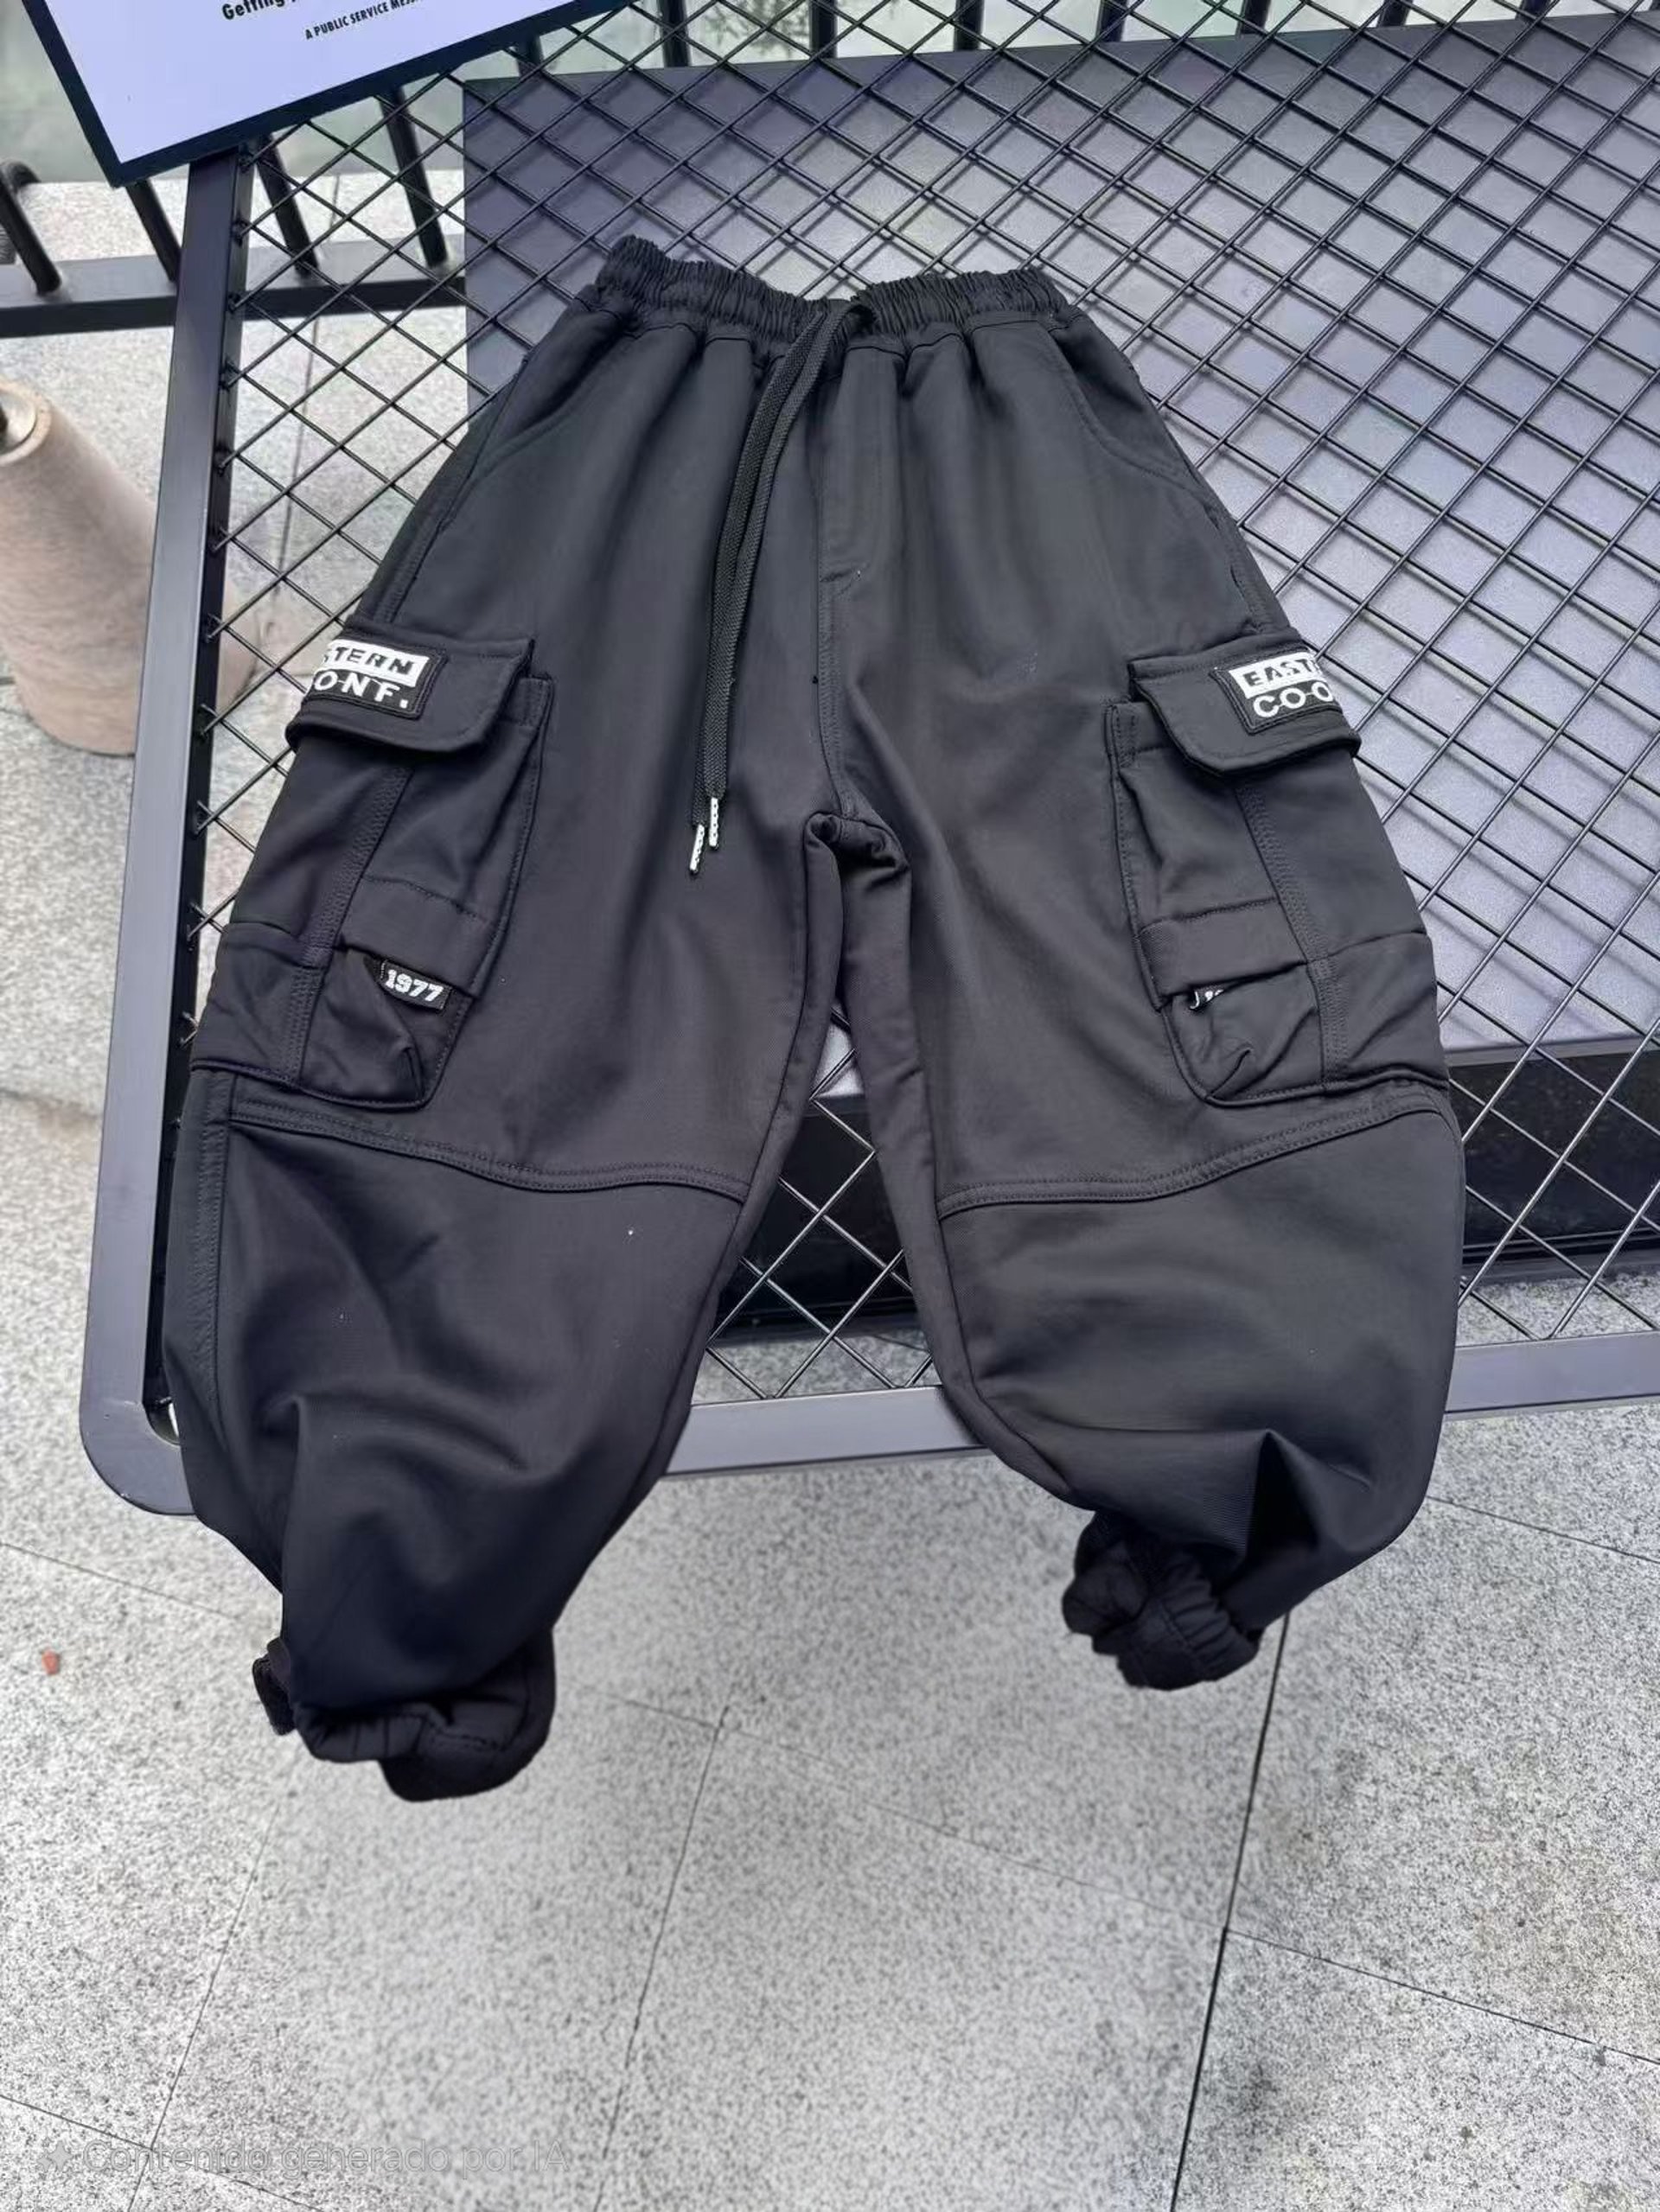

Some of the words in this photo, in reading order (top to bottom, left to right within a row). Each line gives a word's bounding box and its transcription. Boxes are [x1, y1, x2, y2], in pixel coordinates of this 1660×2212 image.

[305, 29, 313, 40] A
[313, 16, 349, 36] PUBLIC
[349, 2, 389, 24] SERVICE
[385, 969, 444, 1002] 1977
